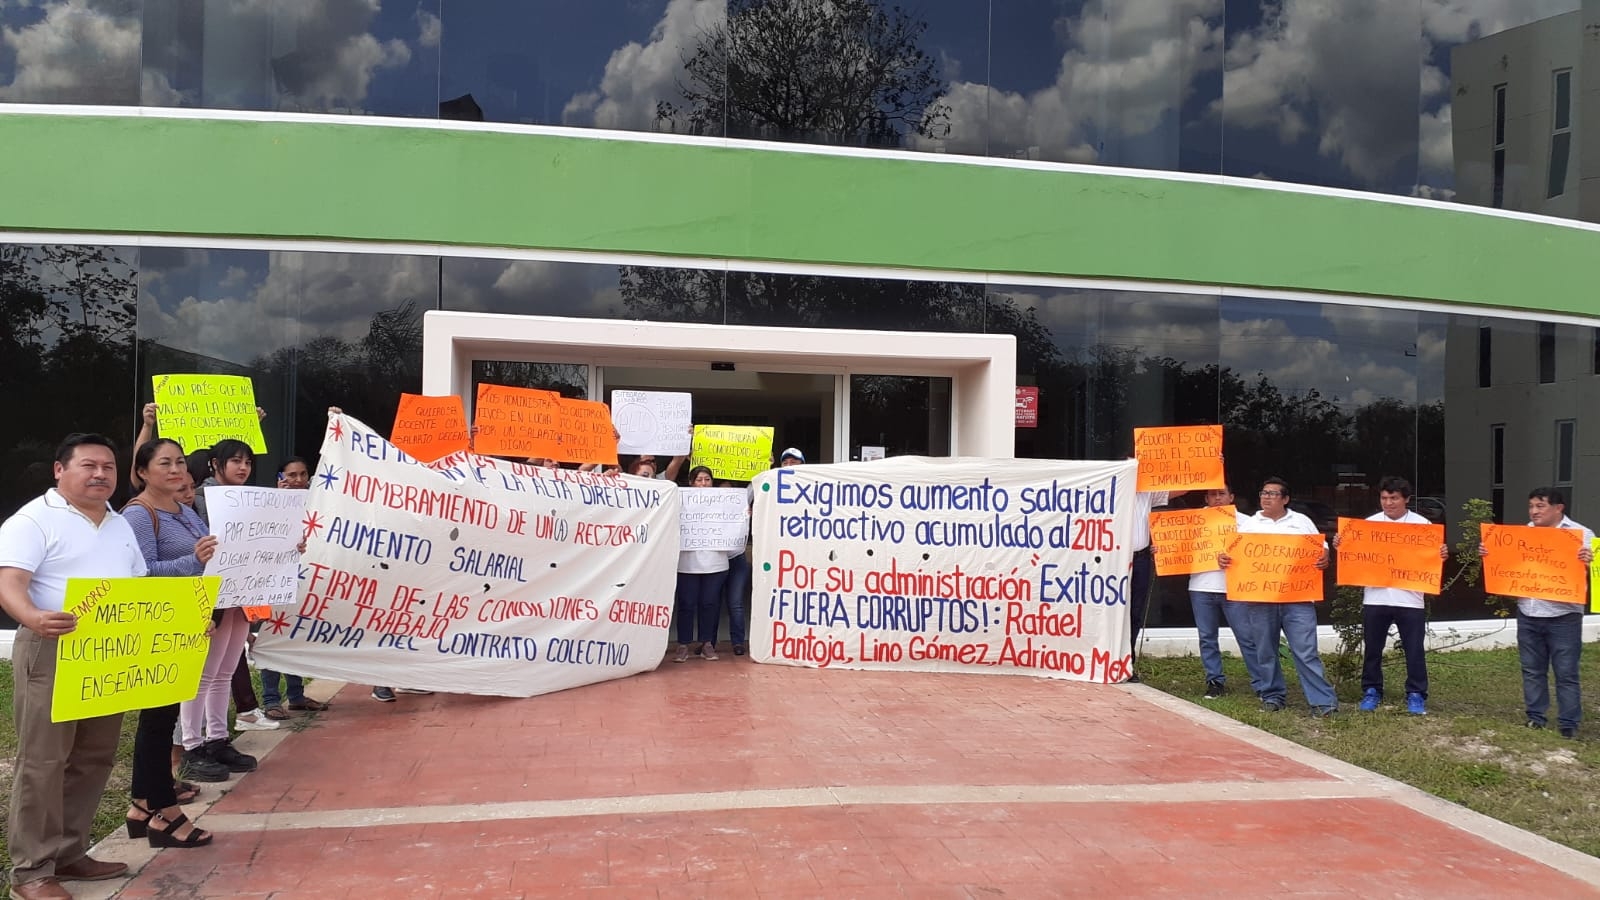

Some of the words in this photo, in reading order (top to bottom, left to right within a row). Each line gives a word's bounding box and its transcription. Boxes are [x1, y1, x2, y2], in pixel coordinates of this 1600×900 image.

[168, 384, 185, 396] UN
[191, 380, 216, 396] PAÍS
[219, 384, 237, 397] QUE
[241, 384, 251, 396] NO
[485, 393, 500, 404] LOS
[157, 401, 199, 415] VALORA
[205, 402, 219, 415] LA
[416, 406, 445, 417] QUIERO
[159, 416, 186, 431] ESTÁ
[190, 417, 246, 430] CONDENADO
[249, 419, 255, 428] A
[398, 418, 437, 429] DOCENTE
[510, 410, 524, 423] EN
[528, 412, 552, 425] LUCHA
[479, 424, 497, 437] POR
[503, 425, 516, 438] UN
[519, 426, 560, 442] SALARIO
[575, 420, 588, 433] QUE
[593, 423, 607, 435] NOS
[705, 430, 725, 440] NUNCA
[394, 433, 433, 444] SALARIO
[500, 439, 532, 451] DIGNO
[594, 436, 606, 449] EL
[1143, 432, 1173, 445] EDUCAR
[1178, 432, 1191, 444] ES
[567, 448, 597, 460] MIEDO
[694, 442, 703, 451] LA
[753, 449, 761, 460] DE
[1171, 447, 1184, 459] EL
[692, 456, 726, 468] NUESTRO
[730, 459, 769, 471] SILENCIO
[1159, 461, 1172, 473] DE
[1178, 460, 1191, 472] LA
[730, 471, 749, 479] VEZ
[1149, 471, 1207, 486] IMPUNIDAD
[500, 472, 526, 493] LA
[533, 478, 573, 501] ALTA
[580, 484, 660, 509] DIRECTIVA
[776, 469, 894, 517] Exigimos
[899, 477, 1010, 513] aumento
[1020, 475, 1117, 515] salarial
[343, 470, 498, 530] NOMBRAMIENTO
[507, 509, 528, 535] DE
[1160, 514, 1206, 527] EXIGIMOS
[224, 520, 244, 544] POR
[780, 509, 905, 544] retroactivo
[914, 513, 1044, 549] acumulado
[1048, 514, 1071, 549] al
[1071, 519, 1121, 552] 2015.
[1154, 527, 1212, 541] CONDICIONES
[1181, 541, 1213, 553] DIGNAS
[1220, 537, 1226, 548] Y
[1352, 530, 1364, 542] DE
[1371, 530, 1435, 547] PROFESORES
[1494, 530, 1513, 548] NO
[1518, 539, 1555, 554] Rector
[327, 516, 432, 565] AUMENTO
[449, 546, 527, 582] SALARIAL
[219, 551, 251, 566] DIGNA
[1157, 554, 1194, 568] SALARIO
[1198, 550, 1222, 563] JUST
[1339, 551, 1385, 565] PASAMOS
[1387, 553, 1395, 565] A
[778, 549, 818, 590] Por
[825, 566, 854, 594] su
[864, 557, 1031, 602] administración
[1250, 561, 1318, 576] SOLICITAMOS
[1490, 564, 1568, 584] Necesitamos
[240, 571, 277, 590] JÓVENES
[280, 575, 293, 588] DE
[1237, 581, 1258, 593] NOS
[1263, 579, 1316, 594] ATIENDA
[231, 594, 264, 607] ZONA
[267, 592, 294, 605] MAYA
[309, 562, 378, 606] FIRMA
[390, 585, 423, 614] DE
[433, 591, 470, 620] LAS
[478, 596, 599, 623] CONDICIONES
[609, 599, 670, 629] GENERALES
[95, 601, 175, 624] MAESTROS
[300, 593, 334, 621] DE
[352, 603, 450, 640] TRABAJO
[1005, 602, 1082, 639] Rafael
[60, 632, 142, 662] LUCHANDO
[150, 631, 209, 654] ESTAMOS
[290, 614, 364, 649] FIRMA
[437, 632, 537, 662] CONTRATO
[546, 637, 630, 666] COLECTIVO
[771, 621, 854, 668] Pantoja,
[859, 631, 903, 663] Lino
[998, 636, 1085, 675] Adriano
[81, 663, 179, 701] ENSEÑANDO
